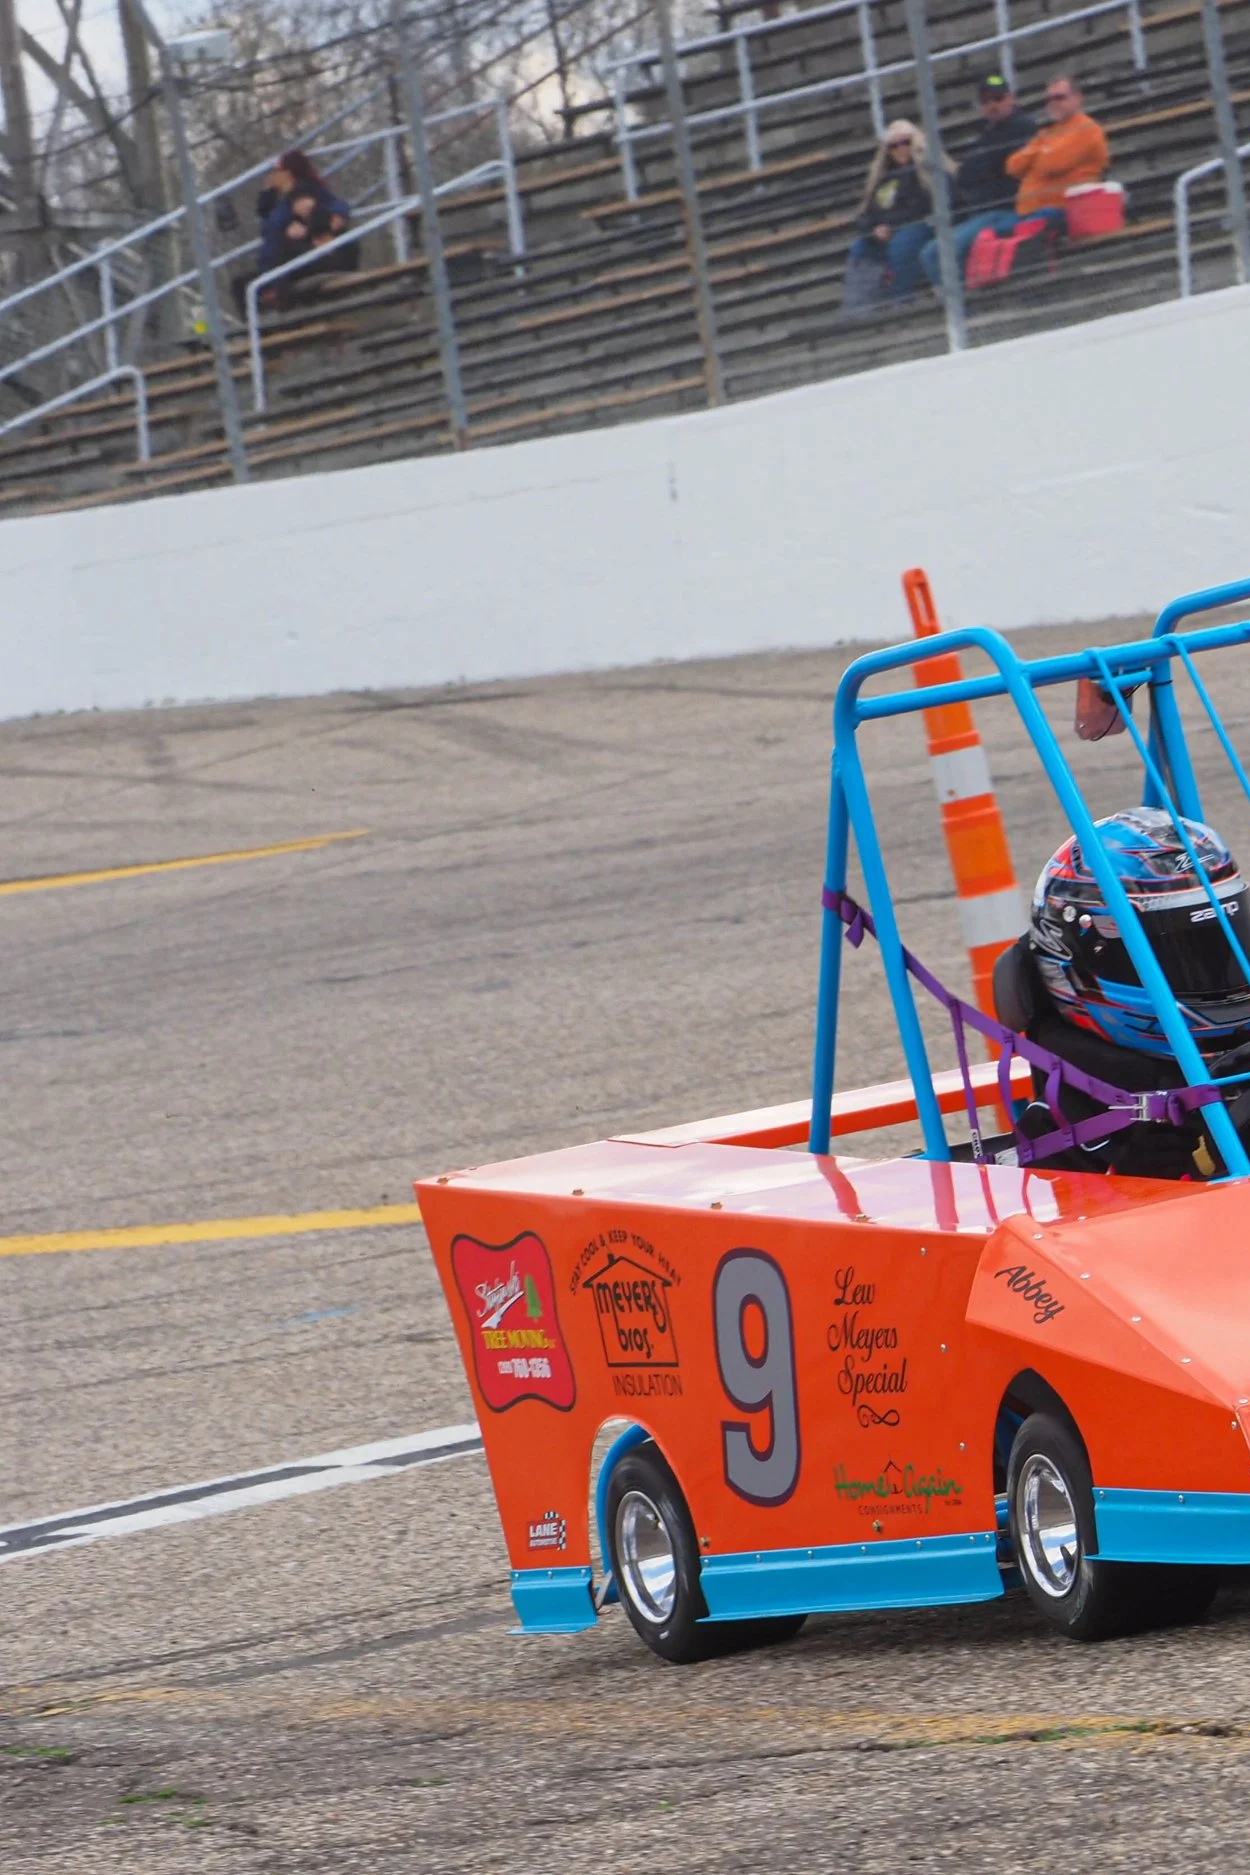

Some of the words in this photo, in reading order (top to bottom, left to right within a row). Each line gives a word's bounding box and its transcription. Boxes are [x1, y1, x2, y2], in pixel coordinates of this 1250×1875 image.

[580, 1239, 599, 1266] COOL
[608, 1229, 628, 1243] KEEP
[631, 1234, 655, 1257] YOUR
[833, 1265, 876, 1306] Lew
[994, 1265, 1065, 1325] Abbey
[826, 1311, 898, 1362] Meyers
[612, 1374, 684, 1397] INSULATION
[712, 1247, 802, 1508] 9
[837, 1357, 908, 1407] Special
[834, 1461, 891, 1500] Home
[858, 1503, 923, 1516] CONSIGNMENTS
[529, 1522, 558, 1538] LANE
